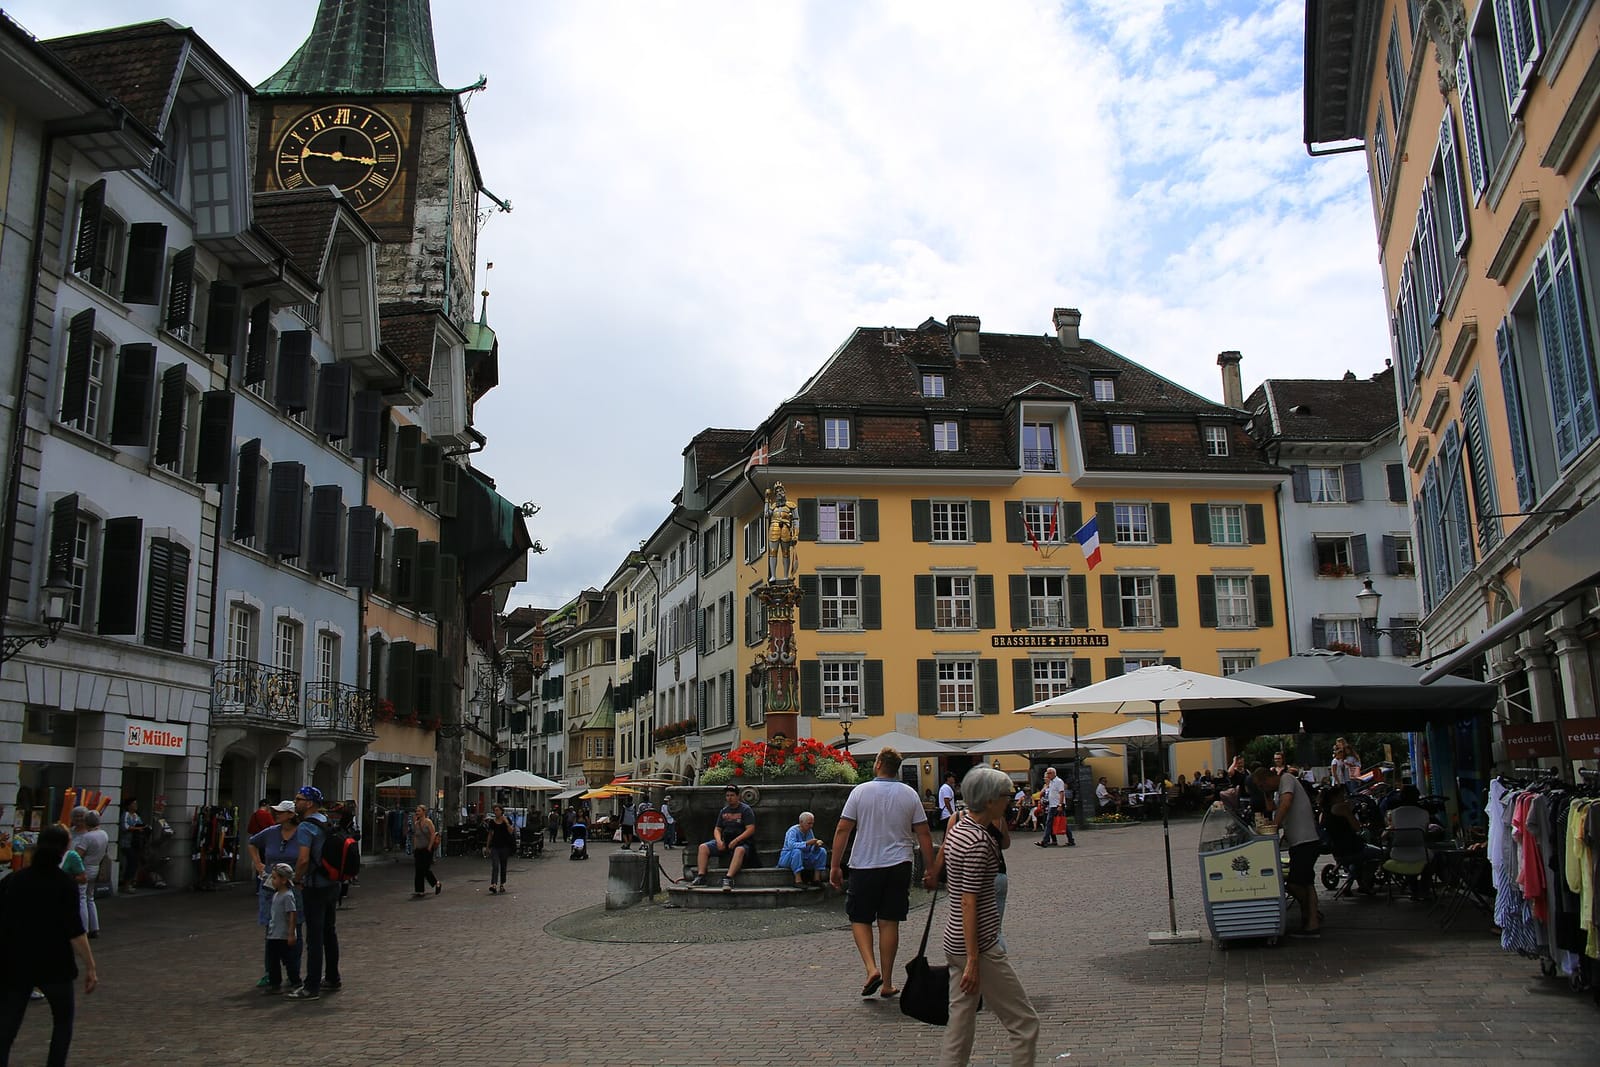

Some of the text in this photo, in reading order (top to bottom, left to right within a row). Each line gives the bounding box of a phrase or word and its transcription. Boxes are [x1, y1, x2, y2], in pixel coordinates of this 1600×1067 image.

[994, 636, 1108, 646] BRASSERIE FEDERALE
[142, 729, 183, 747] Müller
[1507, 734, 1553, 745] reduziert
